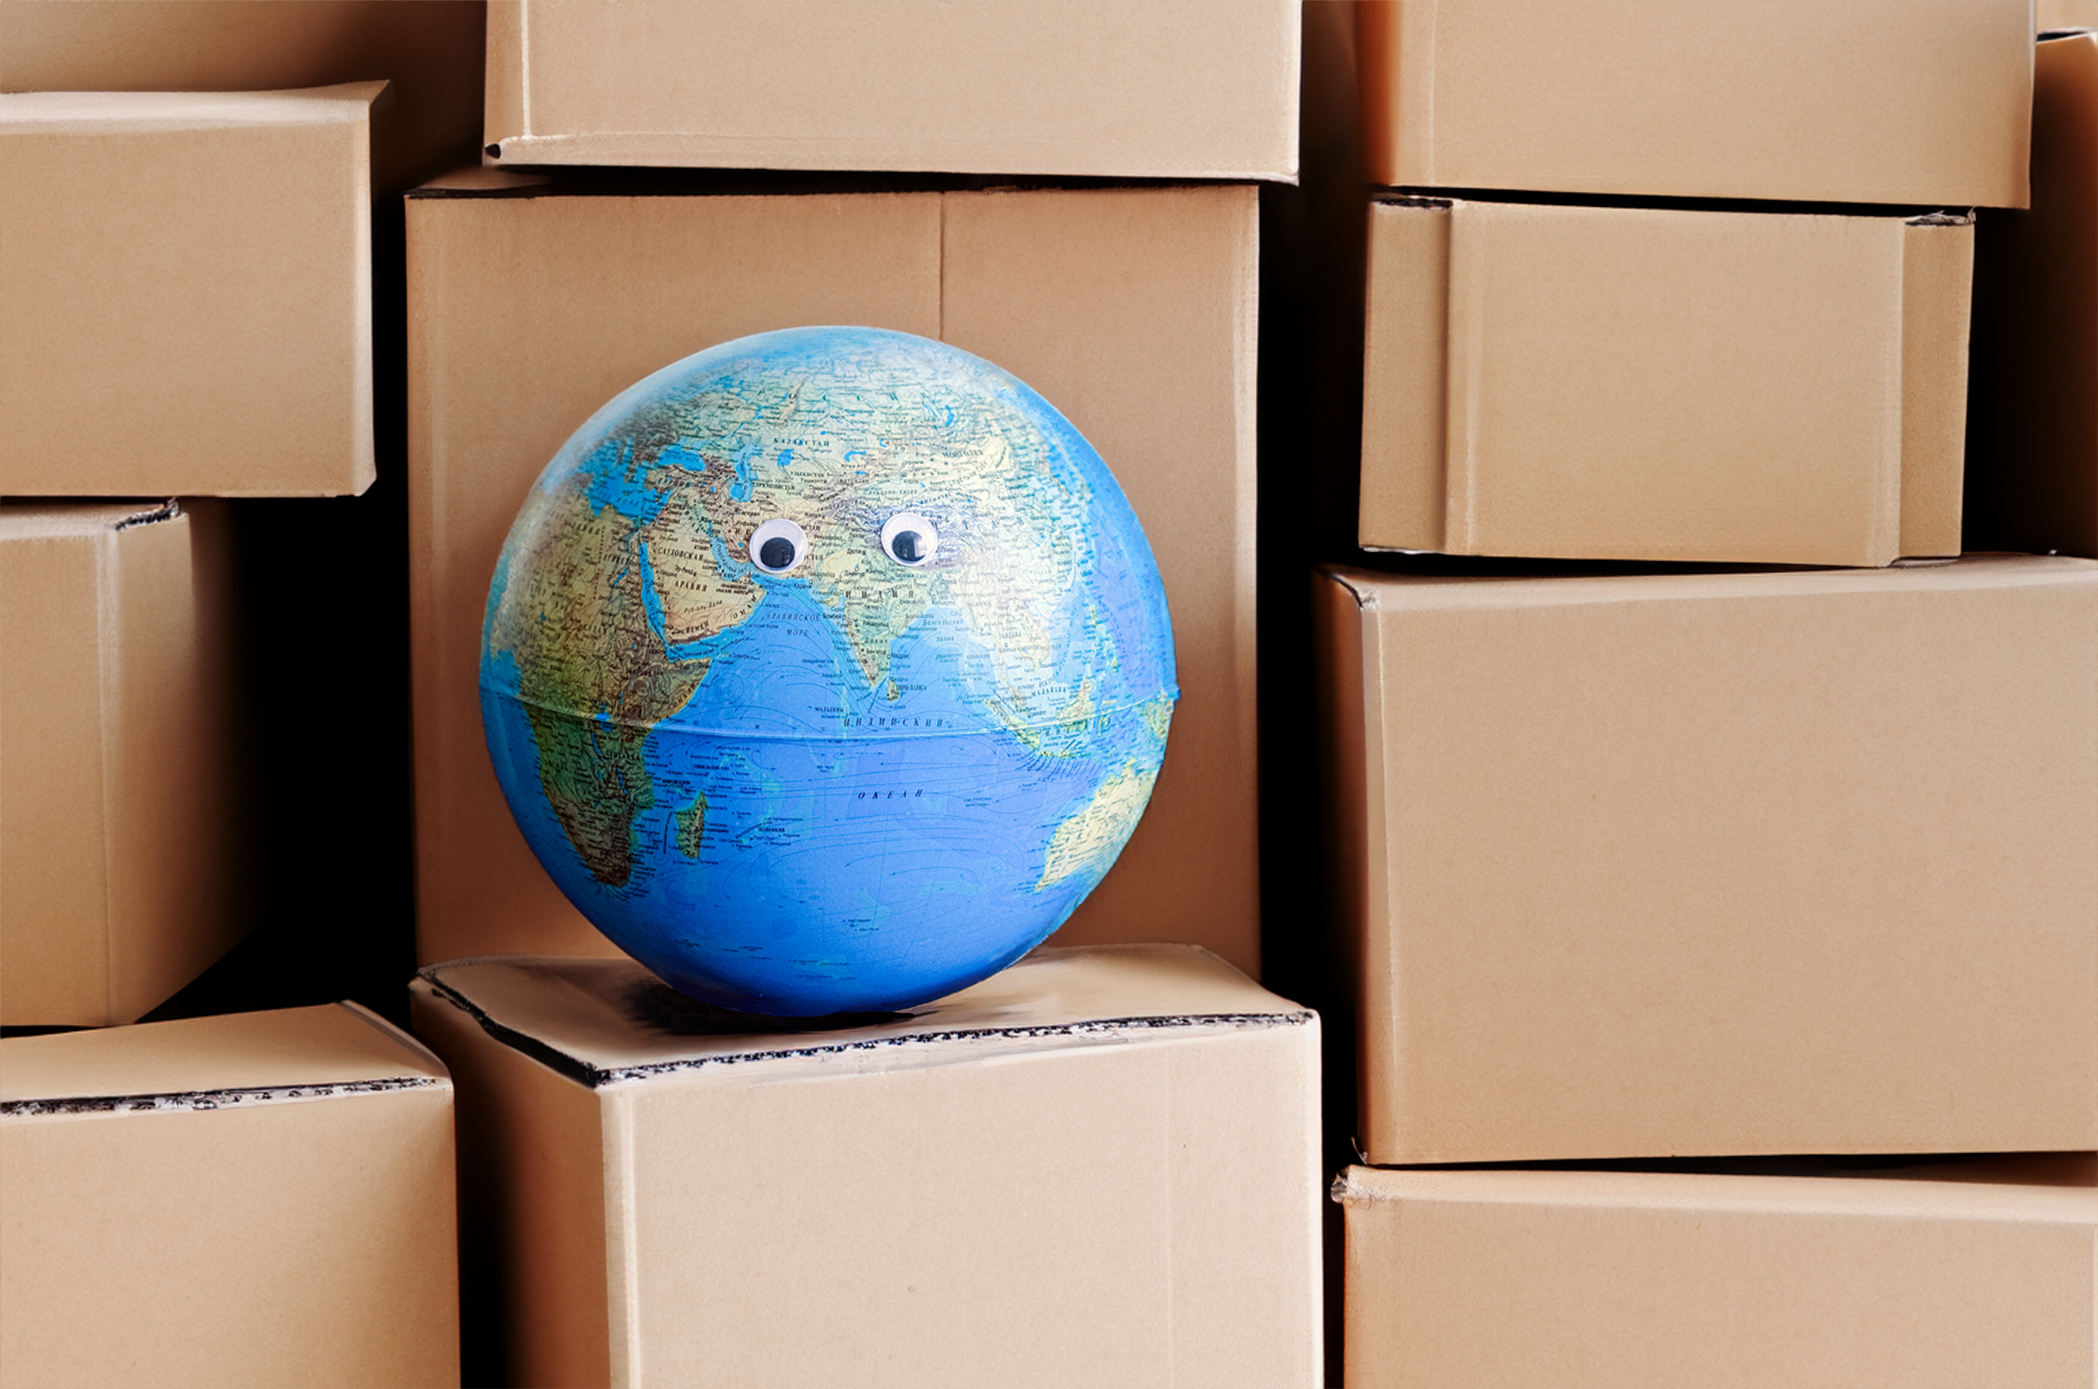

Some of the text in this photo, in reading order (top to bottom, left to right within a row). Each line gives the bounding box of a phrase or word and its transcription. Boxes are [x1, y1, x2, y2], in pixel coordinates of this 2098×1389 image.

[657, 547, 704, 562] САУДОВСКАЯ
[843, 717, 943, 727] ИНДИЙСКИЙ
[857, 788, 924, 800] ОКЕАН
